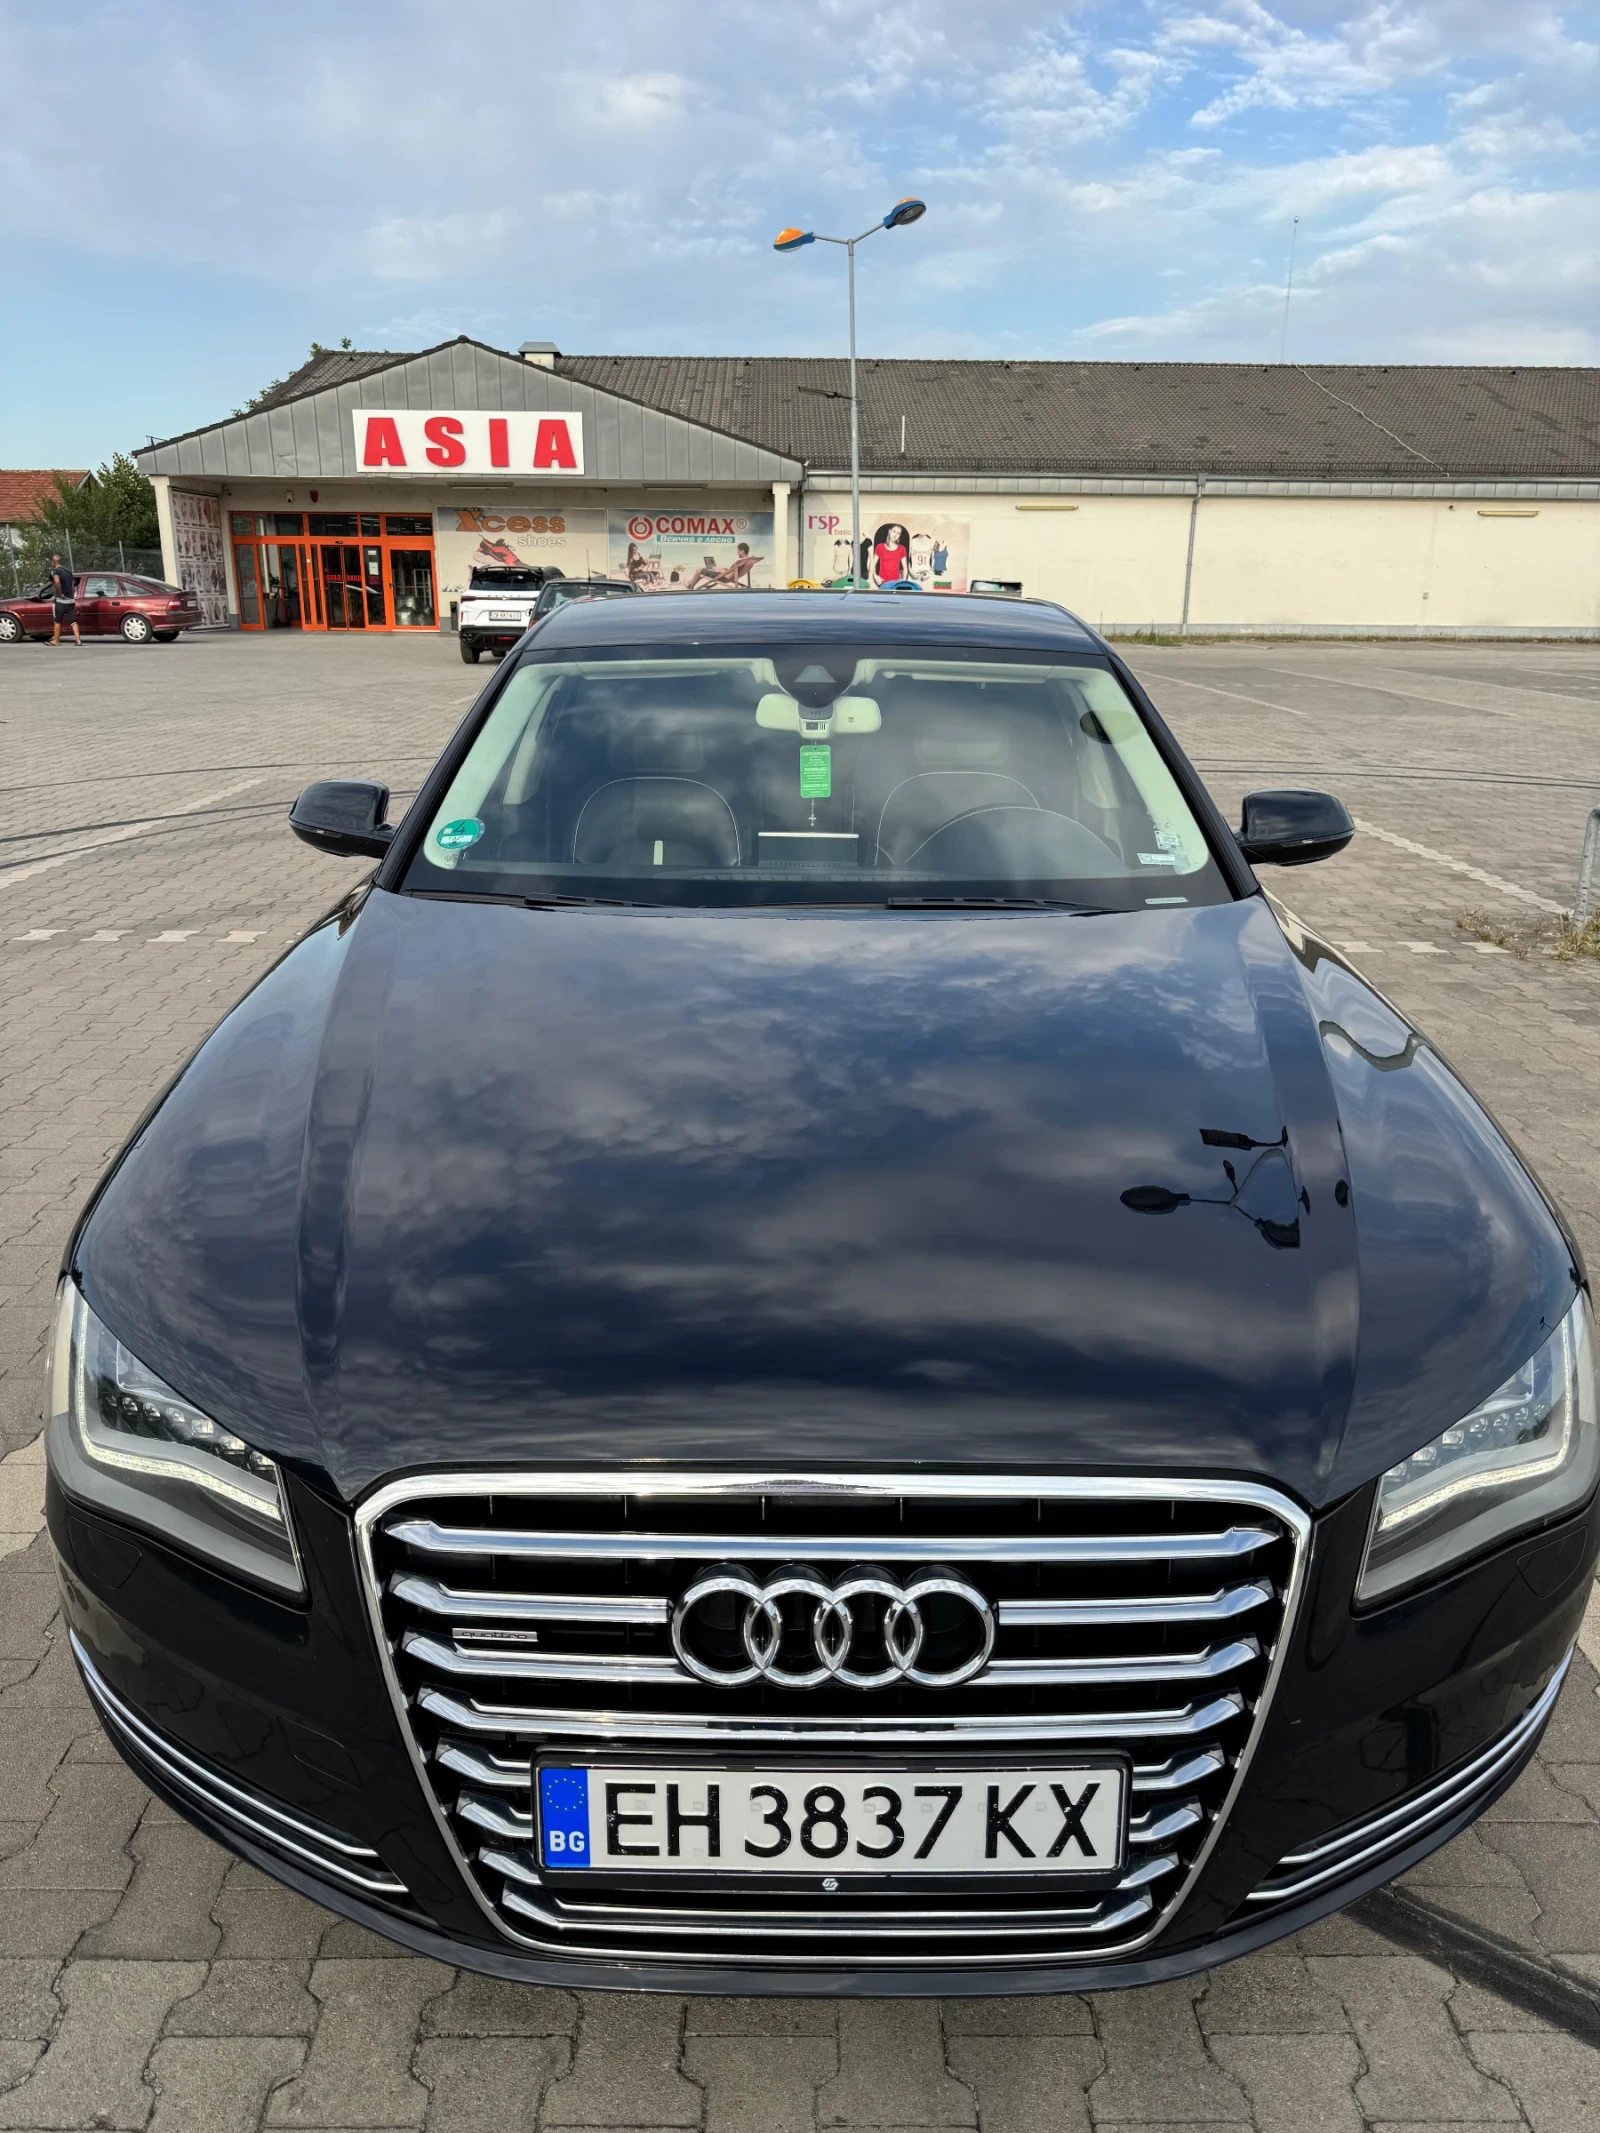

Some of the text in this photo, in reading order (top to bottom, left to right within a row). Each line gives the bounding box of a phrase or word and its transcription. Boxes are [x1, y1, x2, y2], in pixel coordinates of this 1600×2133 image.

[363, 416, 578, 469] ASIA
[455, 510, 566, 534] Xcess
[808, 515, 840, 536] rsp
[517, 534, 566, 547] shoes
[660, 535, 695, 543] Всичко
[704, 536, 733, 544] лесно
[834, 528, 852, 536] basic
[453, 820, 466, 834] 4
[461, 1631, 528, 1640] quattro
[605, 1782, 1098, 1860] EH 3837 KX
[548, 1829, 586, 1853] BG
